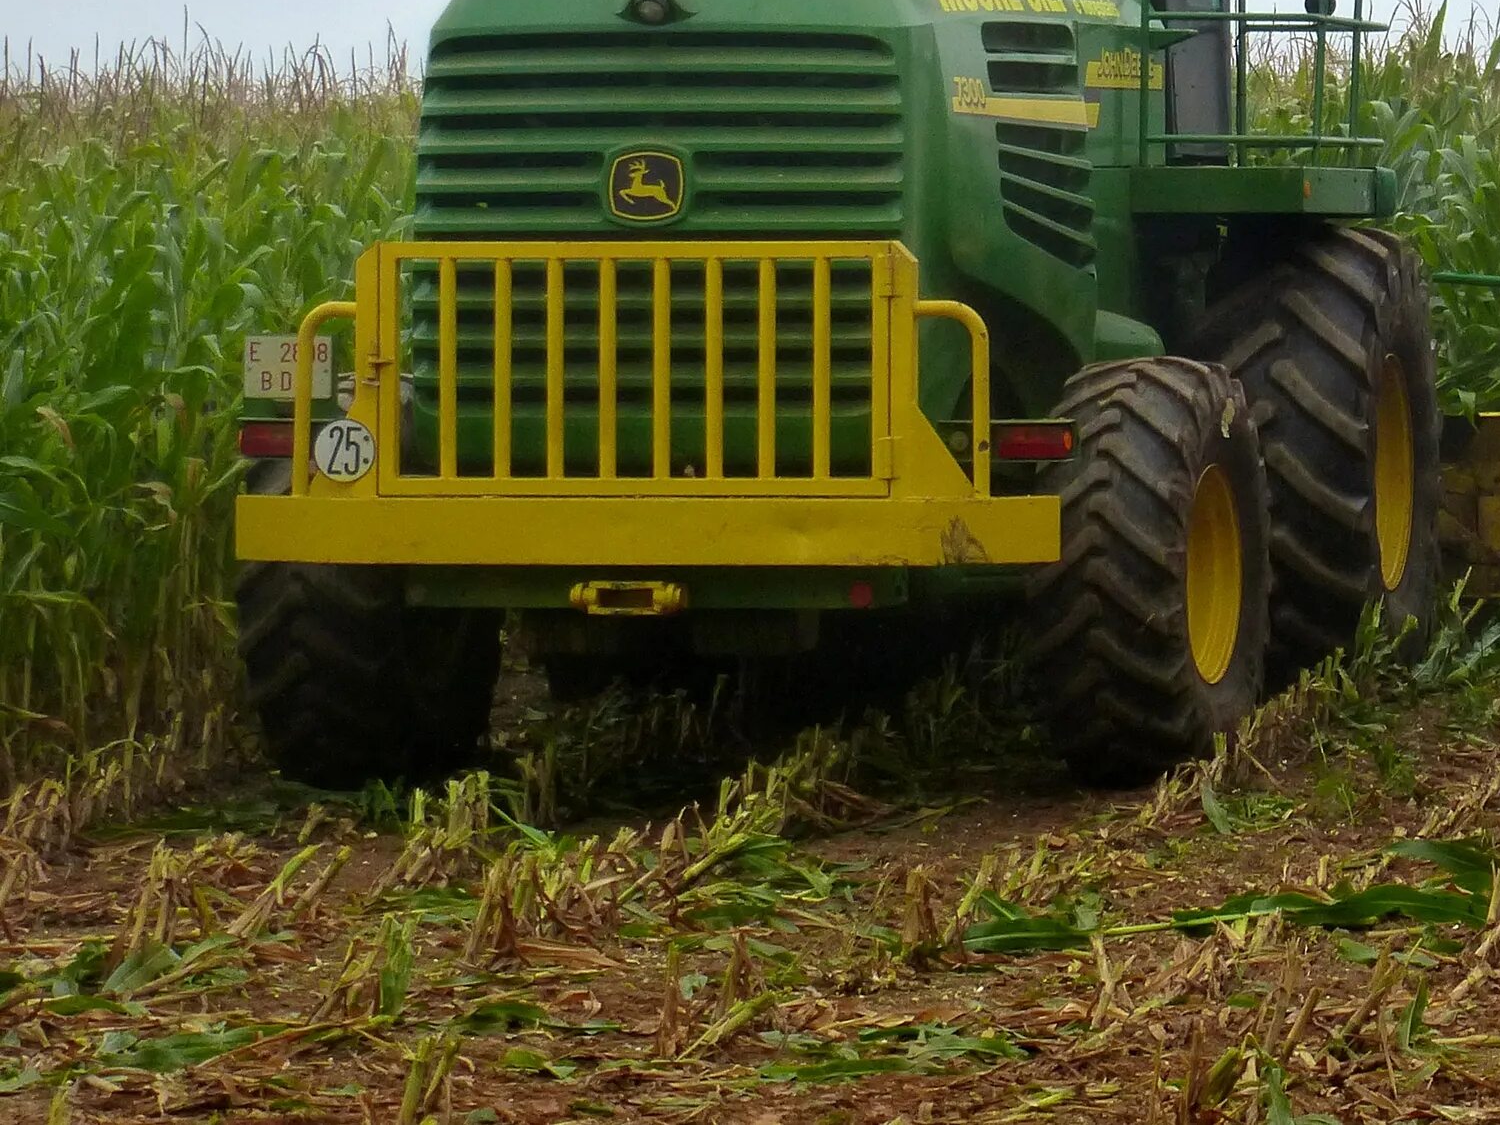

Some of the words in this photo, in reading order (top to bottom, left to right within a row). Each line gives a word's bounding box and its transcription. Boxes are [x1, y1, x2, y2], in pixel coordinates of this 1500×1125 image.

[1122, 47, 1154, 78] DEEE
[954, 77, 987, 109] 7300
[249, 341, 261, 363] E
[280, 342, 328, 363] 28
[327, 426, 362, 475] 25
